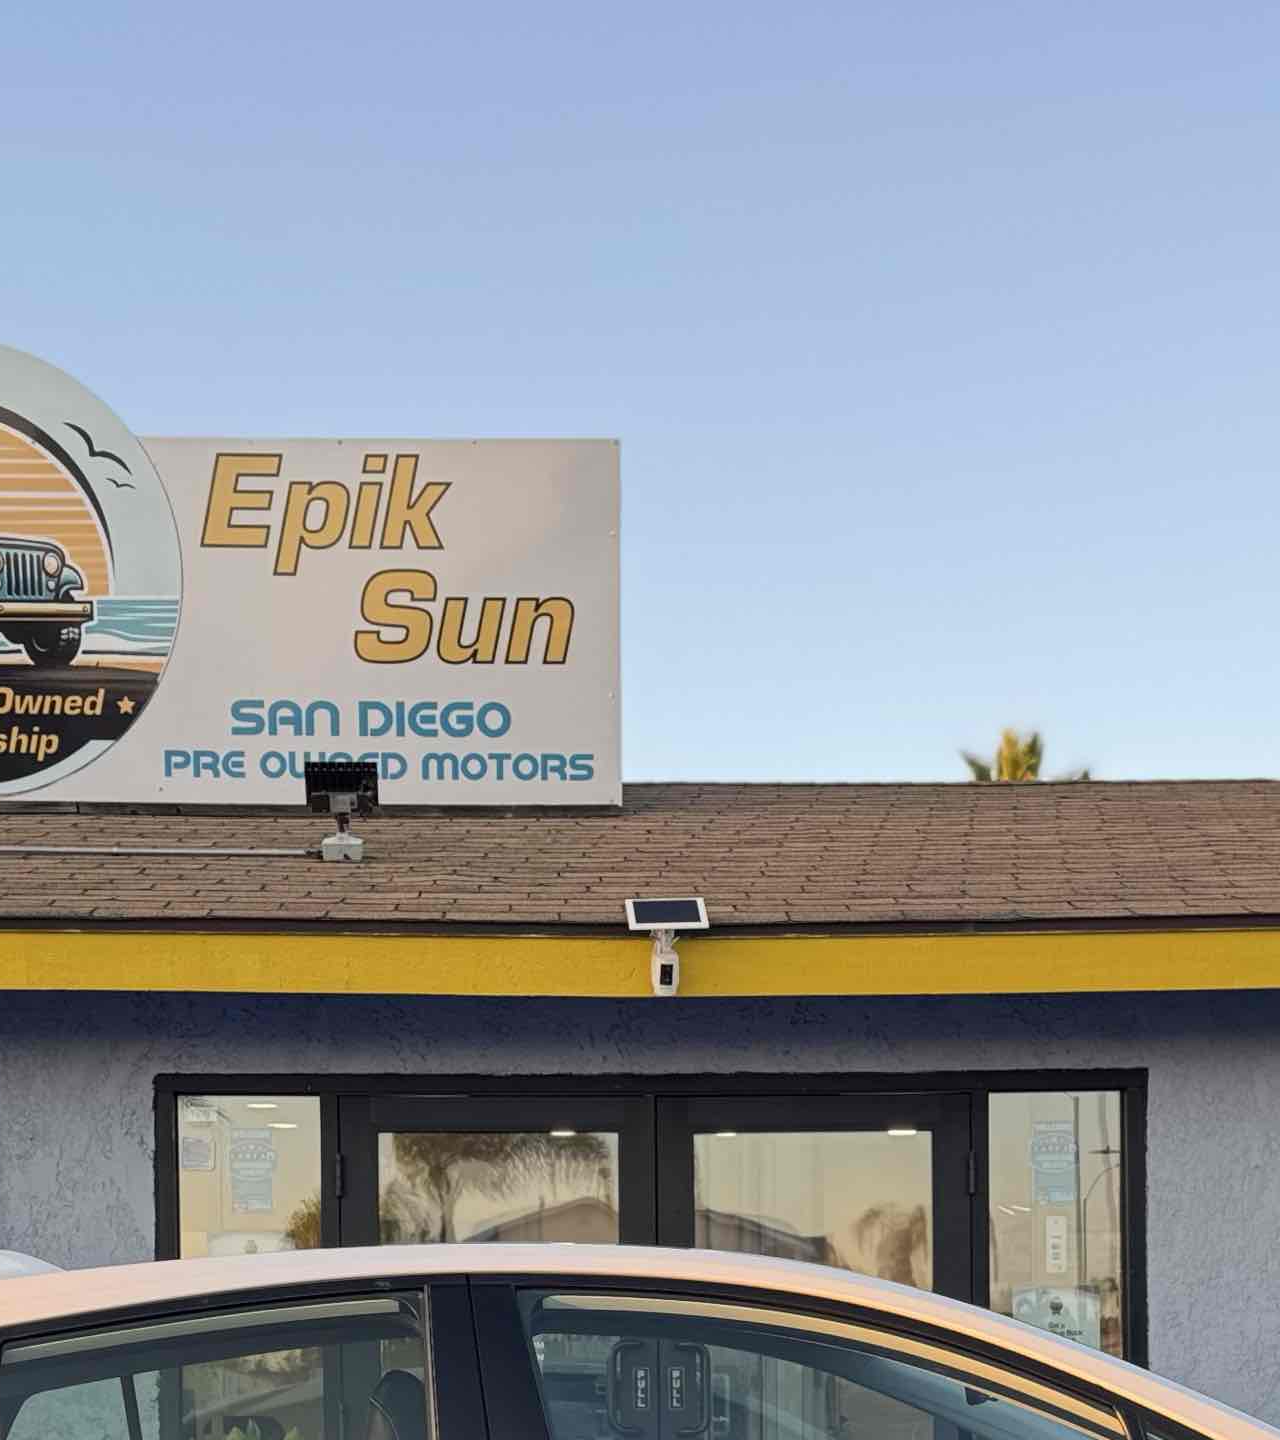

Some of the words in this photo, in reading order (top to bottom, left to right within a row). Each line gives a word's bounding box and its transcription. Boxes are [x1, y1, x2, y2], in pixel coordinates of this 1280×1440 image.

[200, 453, 453, 576] Epik
[354, 568, 575, 665] Sun
[230, 699, 340, 737] SAN
[358, 701, 511, 738] DIEGO
[163, 749, 246, 778] PRE
[421, 752, 595, 781] MOTORS
[636, 1369, 646, 1408] PULL
[671, 1369, 681, 1408] PULL
